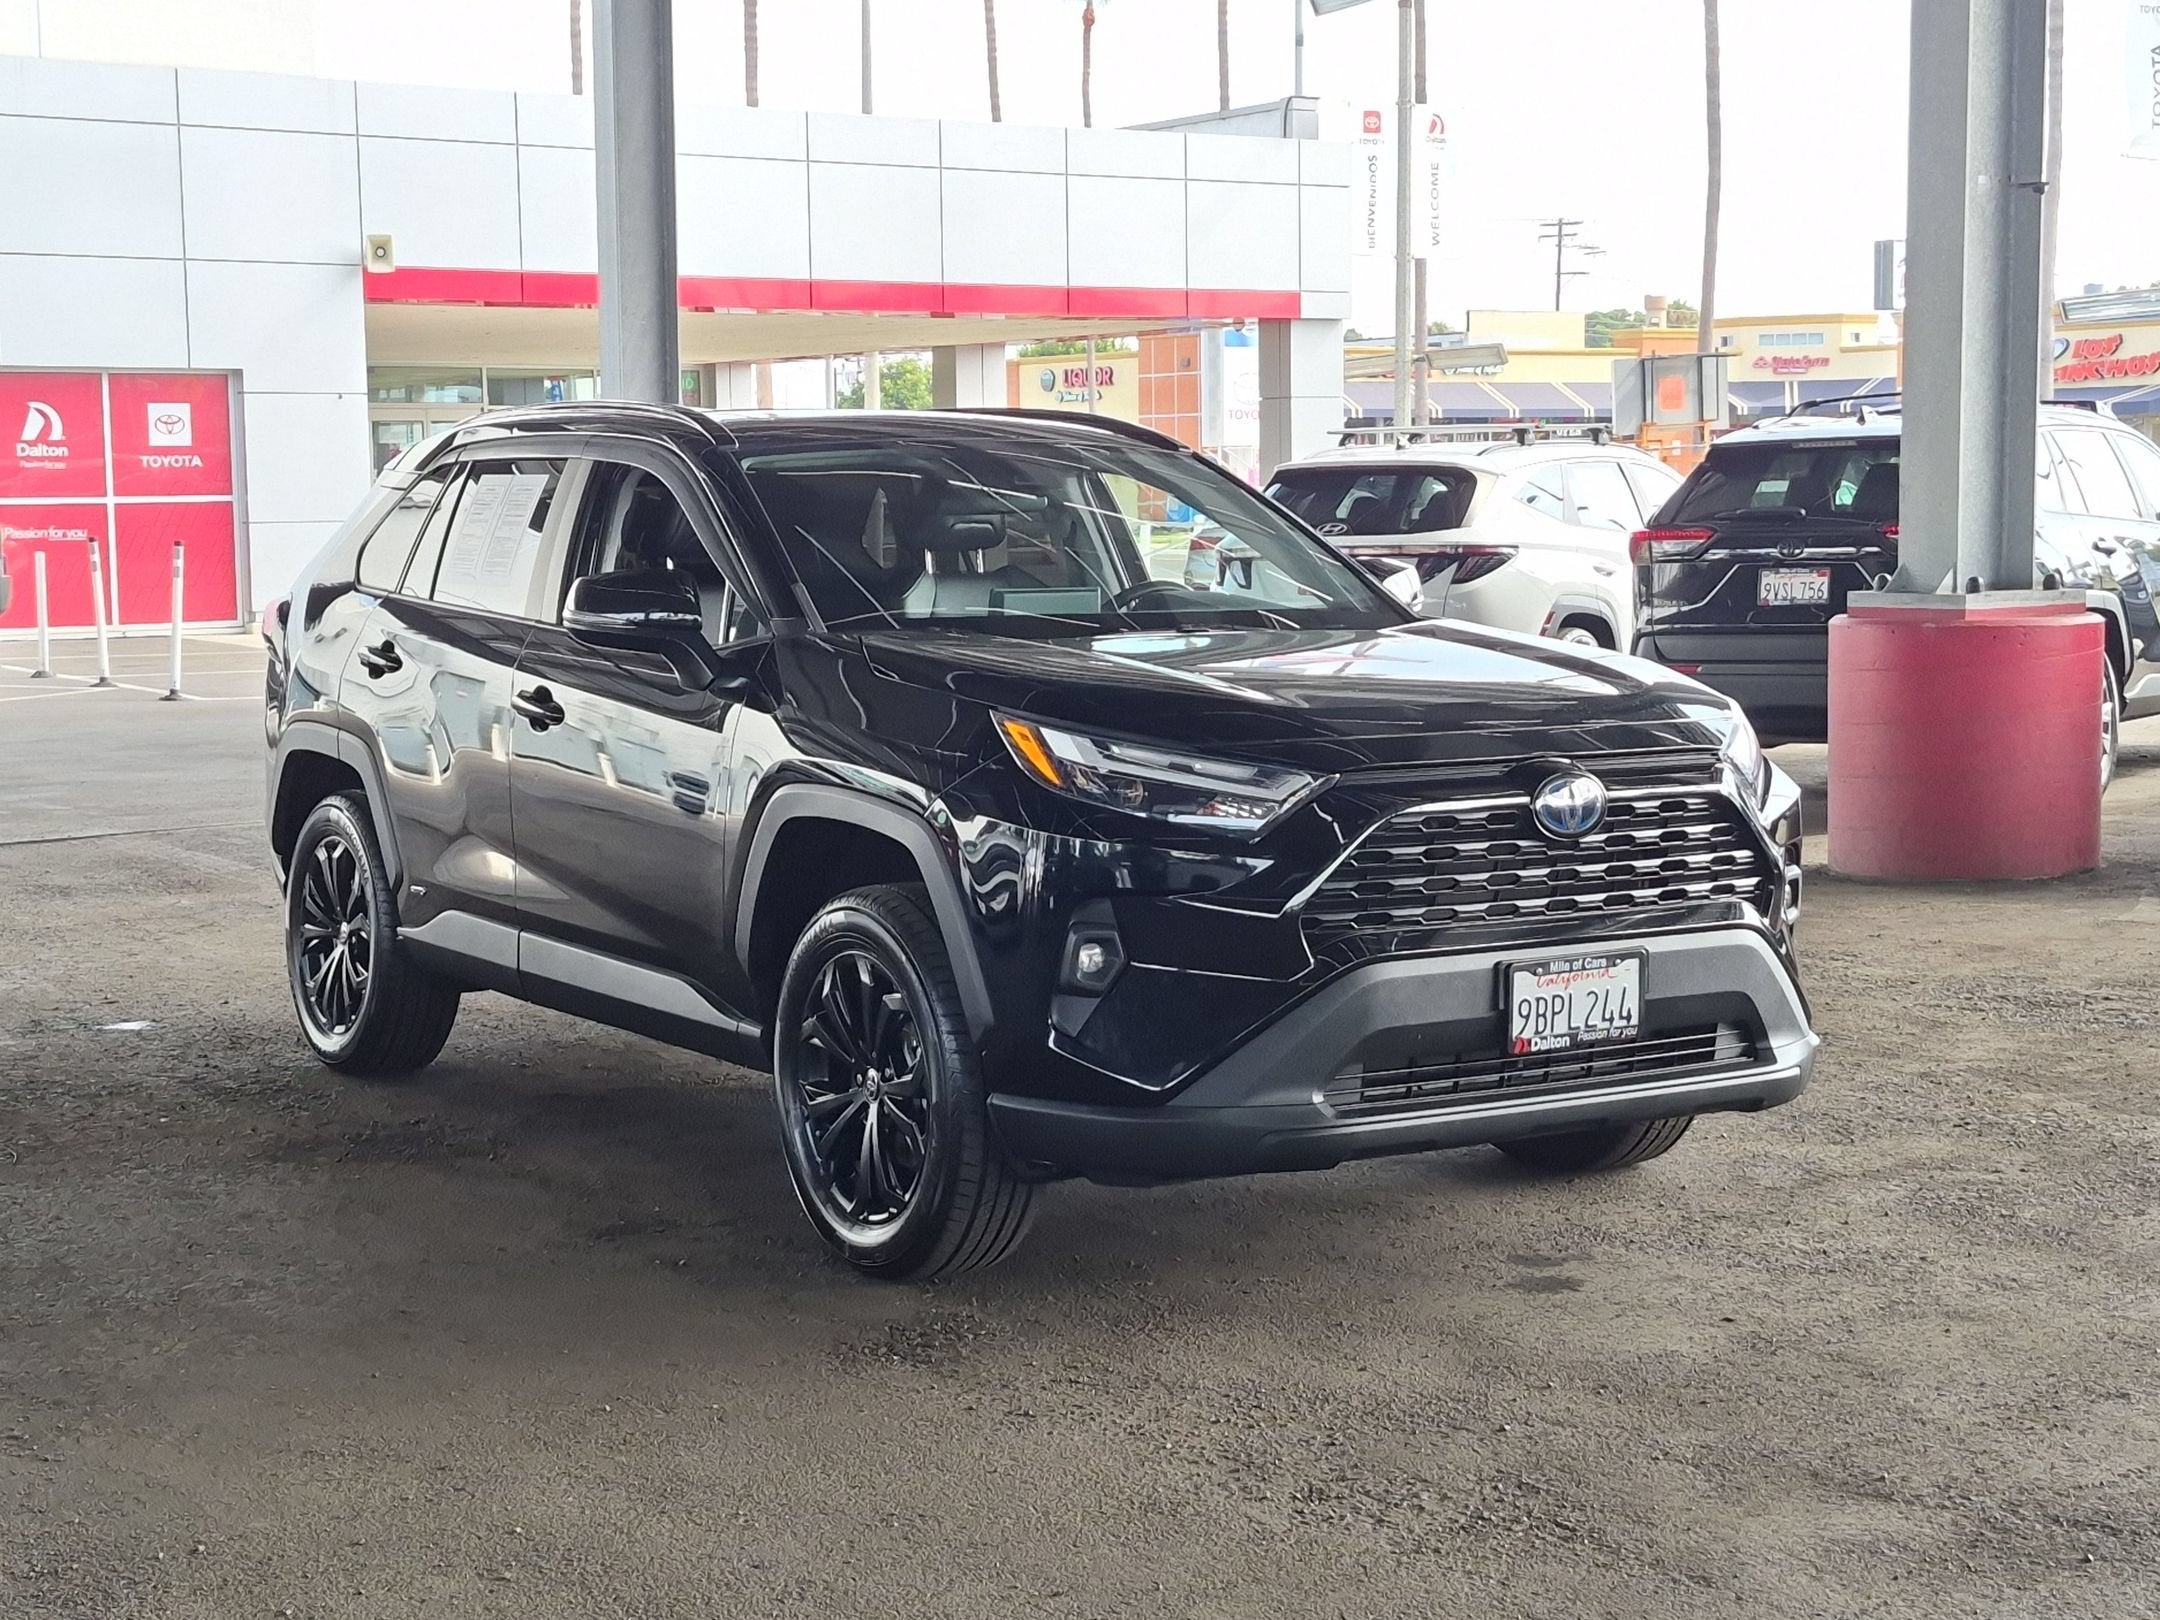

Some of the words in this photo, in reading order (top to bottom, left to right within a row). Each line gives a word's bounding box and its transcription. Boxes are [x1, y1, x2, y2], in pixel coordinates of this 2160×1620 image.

[1430, 162, 1440, 246] WELCOME
[2071, 333, 2123, 359] LOS
[2052, 351, 2160, 382] ANCHOS
[1228, 409, 1260, 420] TOYO
[16, 442, 69, 457] Dalton
[140, 454, 203, 468] TOYOTA
[1764, 581, 1825, 601] 9VSL756
[1550, 960, 1570, 973] Mile
[1573, 959, 1583, 970] of
[1585, 957, 1607, 969] Cars
[1518, 986, 1632, 1035] 9BPL244
[1531, 1035, 1570, 1052] Dalton
[1577, 1030, 1608, 1042] Passion
[1609, 1026, 1622, 1038] for
[1622, 1026, 1638, 1038] you
